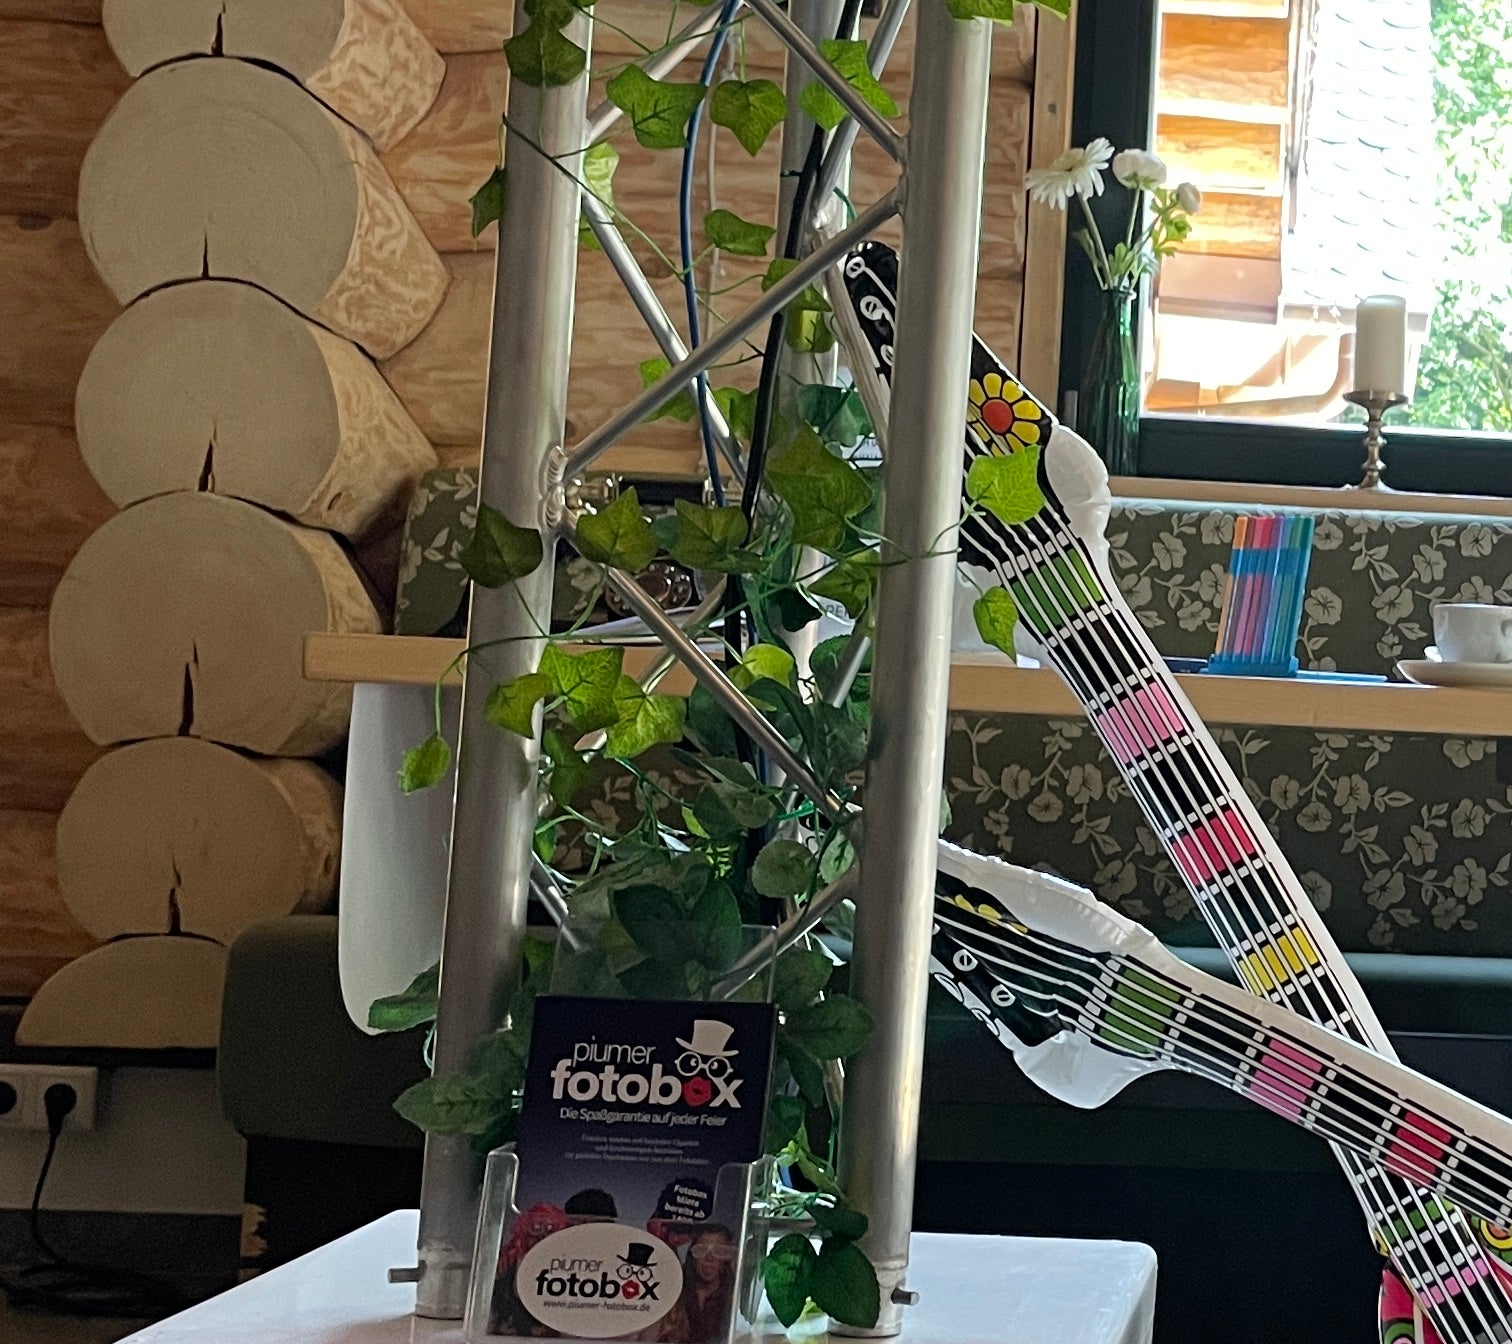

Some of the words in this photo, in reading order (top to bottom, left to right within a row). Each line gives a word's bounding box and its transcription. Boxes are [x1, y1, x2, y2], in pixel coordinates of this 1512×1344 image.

[573, 1036, 656, 1068] piumer
[560, 1107, 579, 1120] Die
[651, 1111, 670, 1124] auf
[700, 1114, 727, 1126] Feier
